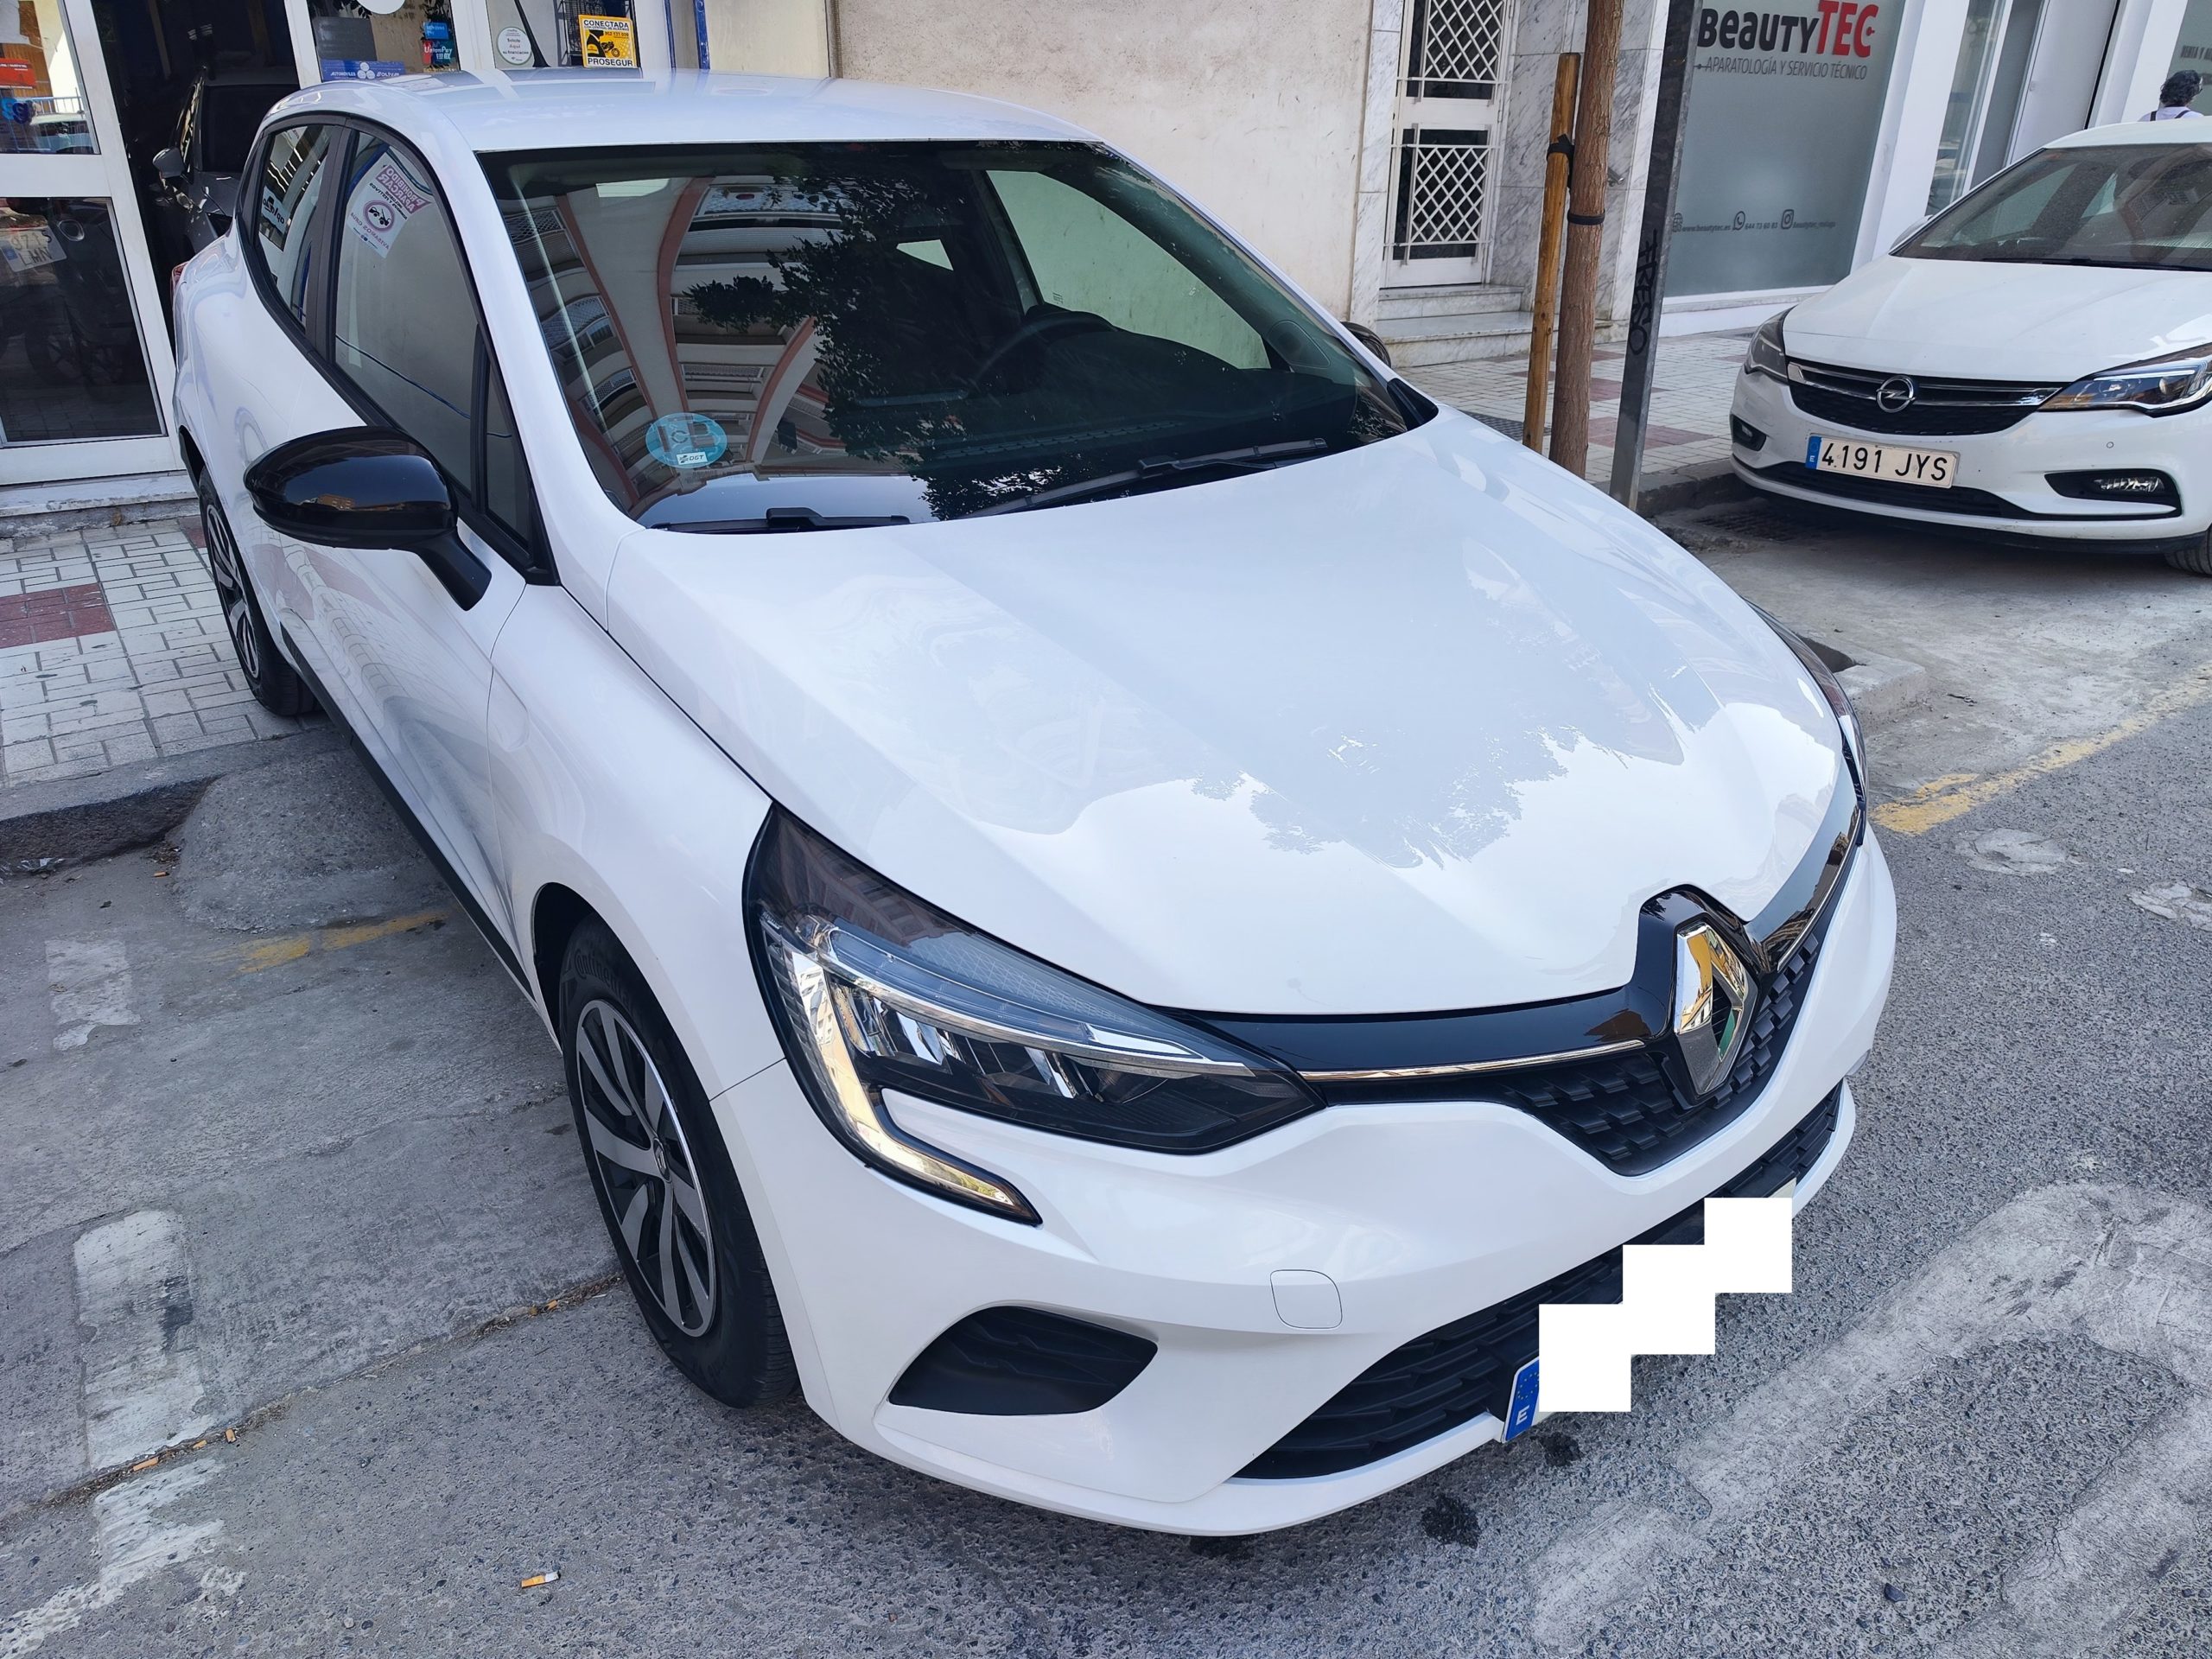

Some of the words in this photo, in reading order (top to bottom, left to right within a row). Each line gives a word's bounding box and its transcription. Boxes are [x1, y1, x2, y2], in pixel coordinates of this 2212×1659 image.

[583, 20, 629, 29] CONECTADA
[424, 46, 453, 54] UnionPay
[588, 58, 633, 67] PROSEGUR
[1706, 56, 1777, 75] APARATOLOGÍA
[1780, 61, 1787, 74] Y
[1788, 61, 1827, 78] SERVICIO
[1829, 60, 1868, 80] TÉCNICO
[1821, 443, 1882, 474] 4191
[1895, 453, 1948, 481] JYS
[1516, 1404, 1530, 1426] E
